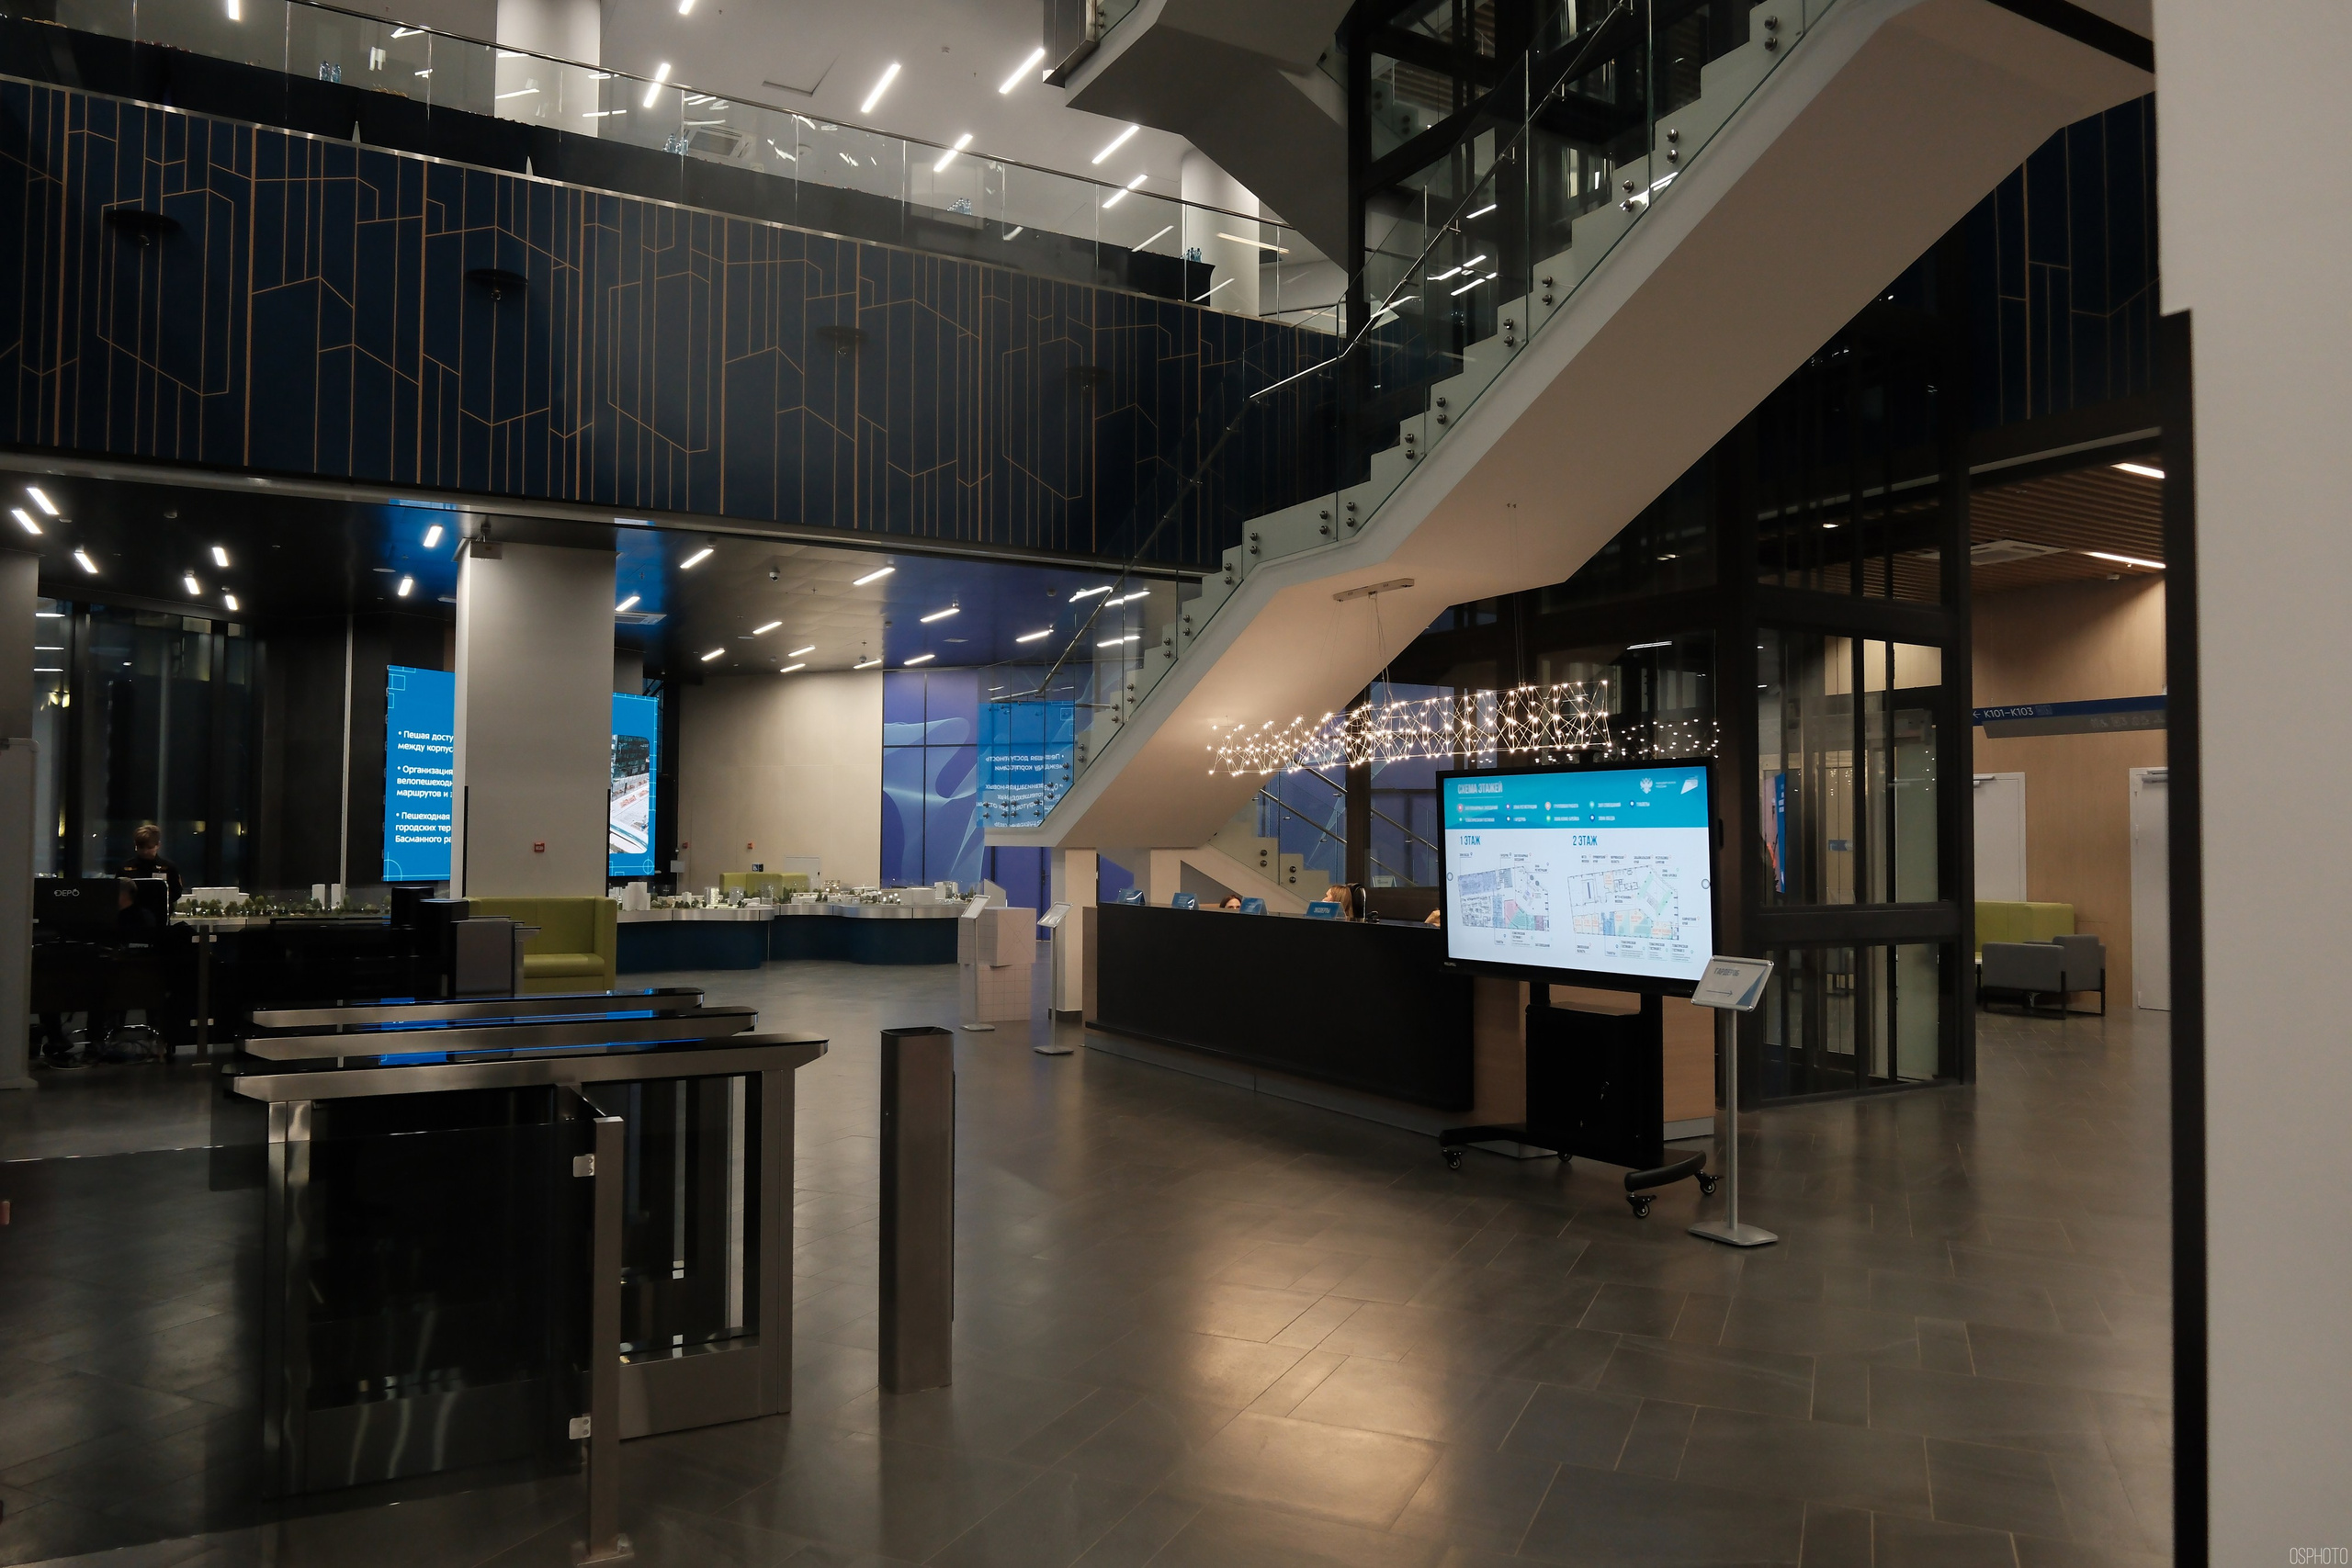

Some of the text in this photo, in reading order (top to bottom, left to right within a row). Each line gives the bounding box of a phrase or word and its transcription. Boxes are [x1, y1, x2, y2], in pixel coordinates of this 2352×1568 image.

[403, 730, 454, 743] Пешая досту
[398, 743, 454, 753] между корпус
[402, 765, 454, 775] Организация
[1458, 781, 1503, 795] СХЕМА ЭТАЖЕЙ
[397, 790, 442, 798] маршрутов
[401, 812, 450, 820] Пешеходная
[395, 824, 436, 832] городских
[395, 835, 442, 843] Басманного
[1464, 835, 1481, 845] ЭТАЖ
[1572, 835, 1598, 846] 2 ЭТАЖ
